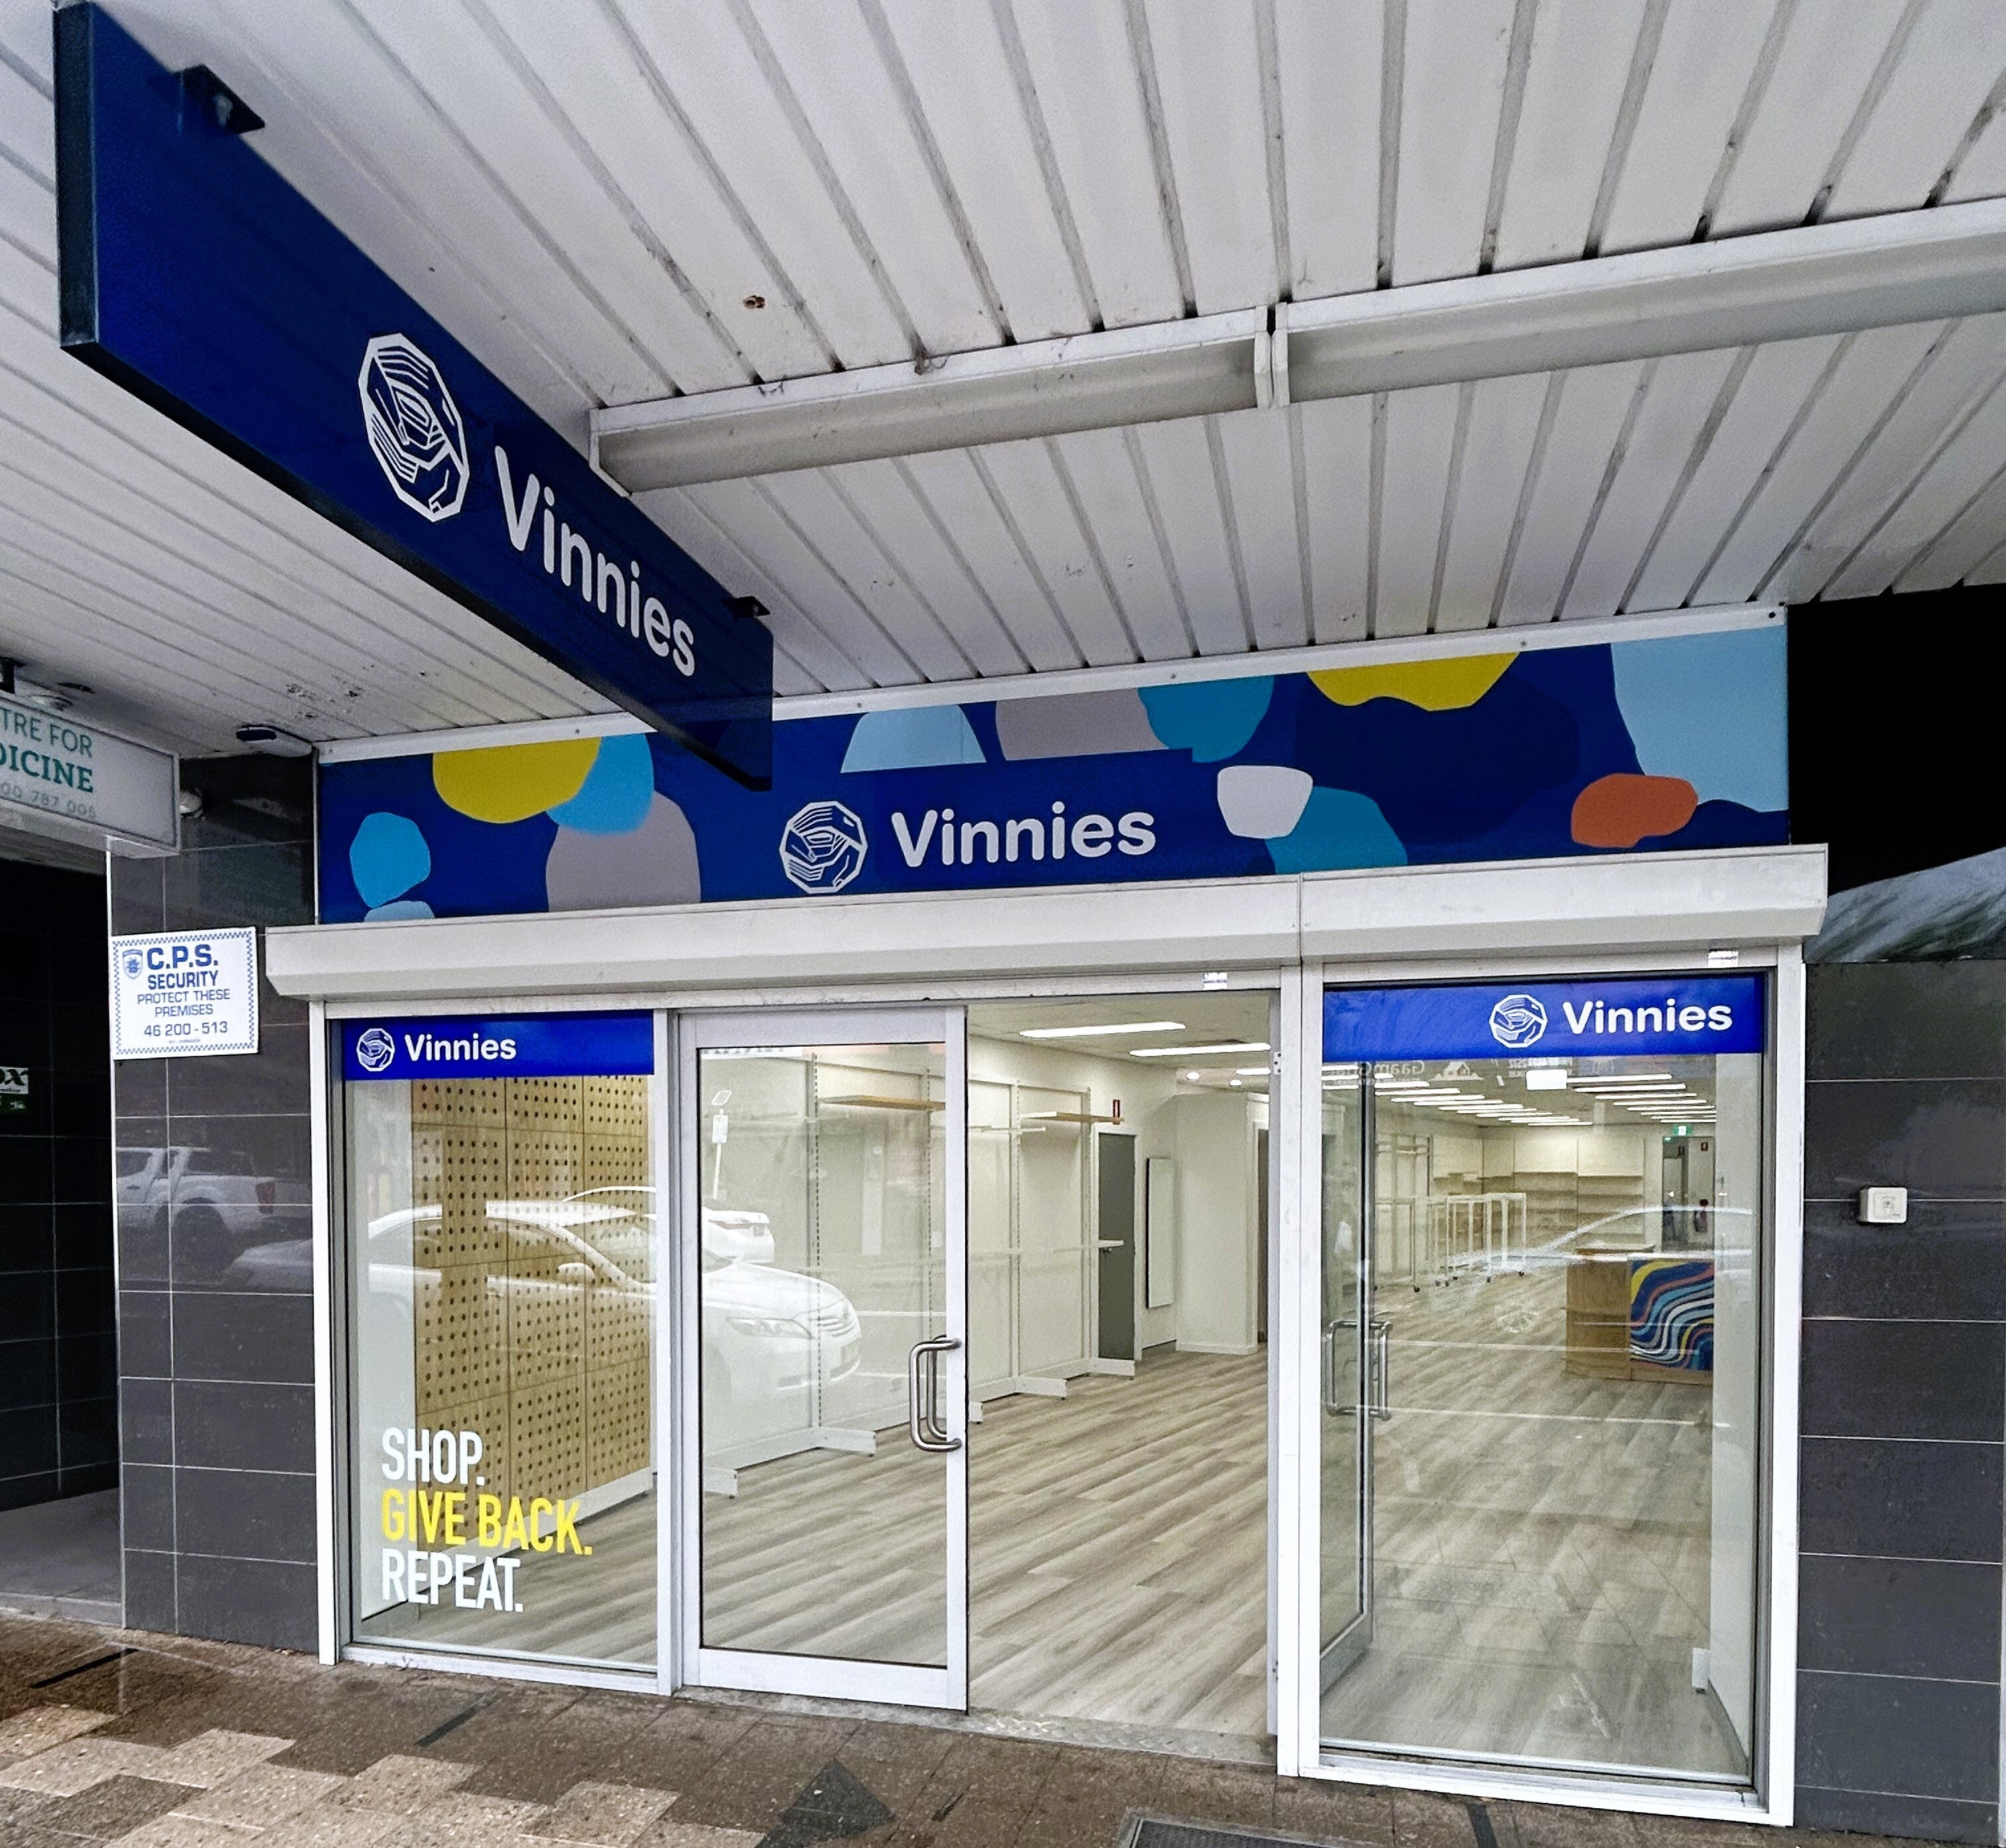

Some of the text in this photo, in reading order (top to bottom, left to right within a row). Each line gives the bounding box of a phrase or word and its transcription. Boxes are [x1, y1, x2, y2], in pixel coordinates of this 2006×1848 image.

[495, 445, 695, 676] Vinnies
[49, 724, 93, 758] FOR
[891, 801, 1156, 867] Vinnies
[147, 944, 219, 970] C.P.S.
[137, 988, 231, 1004] PROTECT THESE
[148, 970, 218, 990] SECURITY
[155, 1004, 214, 1018] PREMISES
[1562, 998, 1732, 1035] Vinnies
[144, 1024, 161, 1037] 46
[165, 1023, 191, 1036] 200
[202, 1021, 228, 1034] 513
[404, 1033, 517, 1061] Vinnies
[381, 1427, 486, 1486] SHOP.
[381, 1488, 593, 1556] GIVE BACK.
[381, 1548, 524, 1613] REPEAT.
